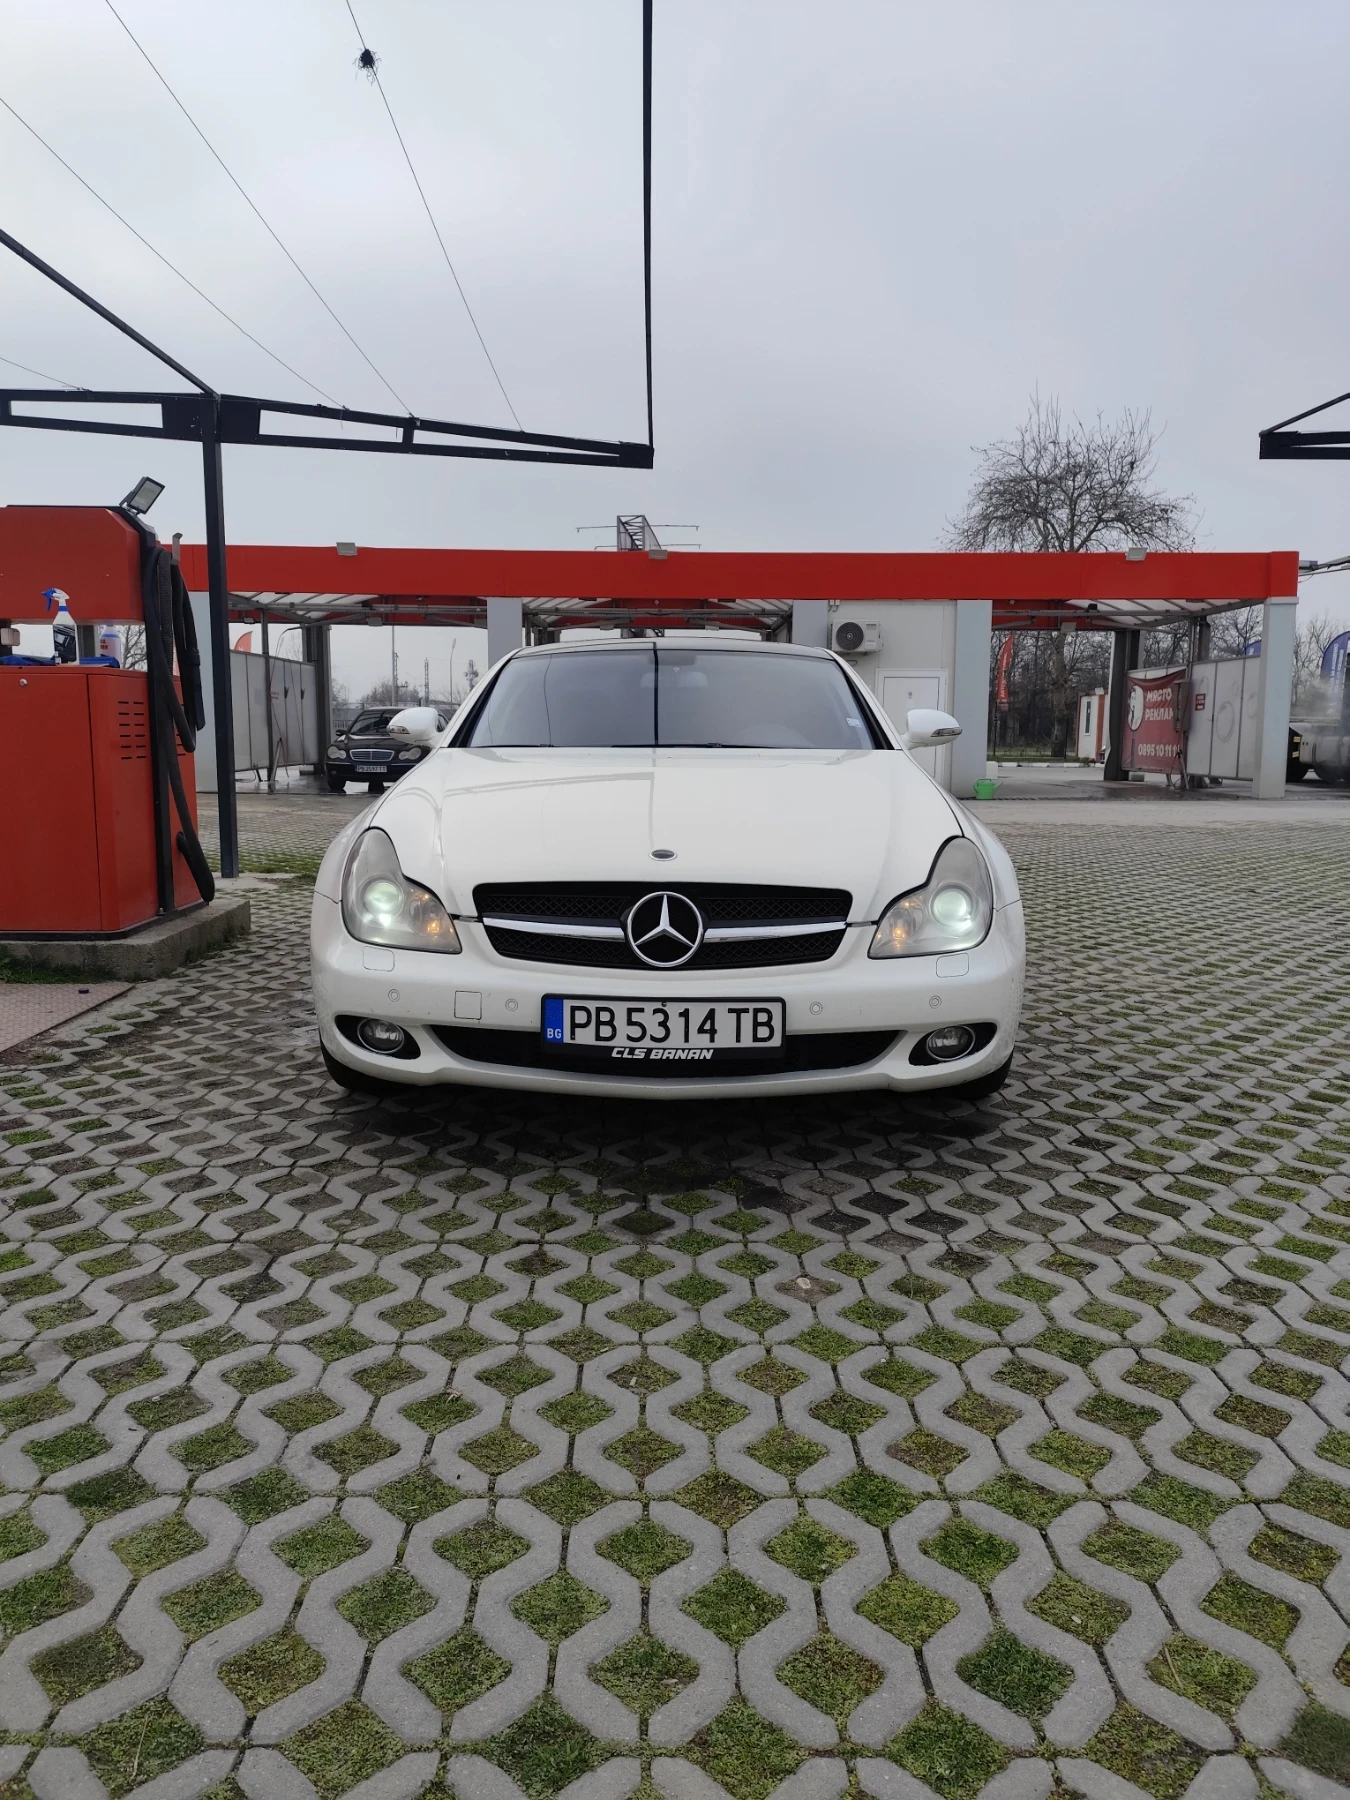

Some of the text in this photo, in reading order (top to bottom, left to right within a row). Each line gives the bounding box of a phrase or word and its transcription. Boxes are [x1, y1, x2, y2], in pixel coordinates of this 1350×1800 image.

[1146, 688, 1172, 702] МЯСТО
[570, 1005, 775, 1043] PB 5314 TB
[547, 1028, 562, 1039] BG
[611, 1047, 714, 1060] CLS BANAN
